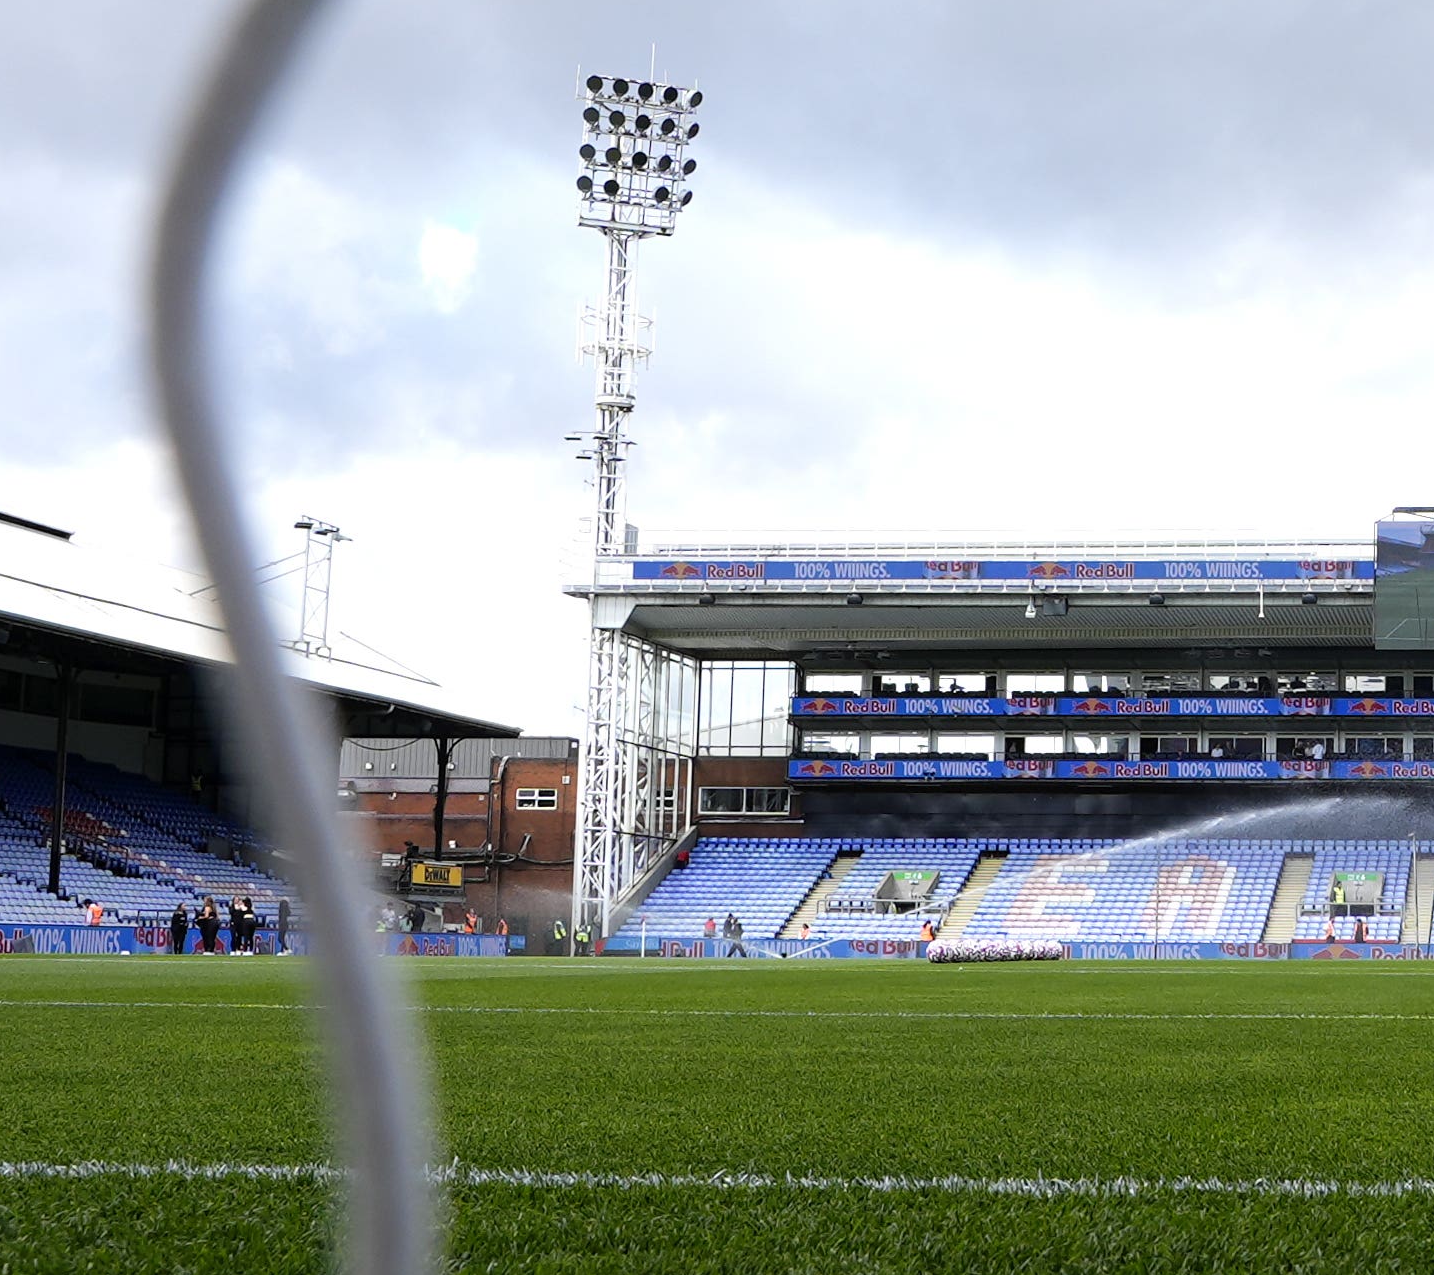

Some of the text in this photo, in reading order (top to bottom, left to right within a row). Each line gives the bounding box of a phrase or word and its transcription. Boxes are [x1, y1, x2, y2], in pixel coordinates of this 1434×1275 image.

[794, 563, 830, 578] 100%
[1164, 563, 1201, 578] 100%
[1178, 699, 1212, 713] 100%
[1177, 762, 1211, 776] 100%
[1080, 943, 1127, 959] 100%
